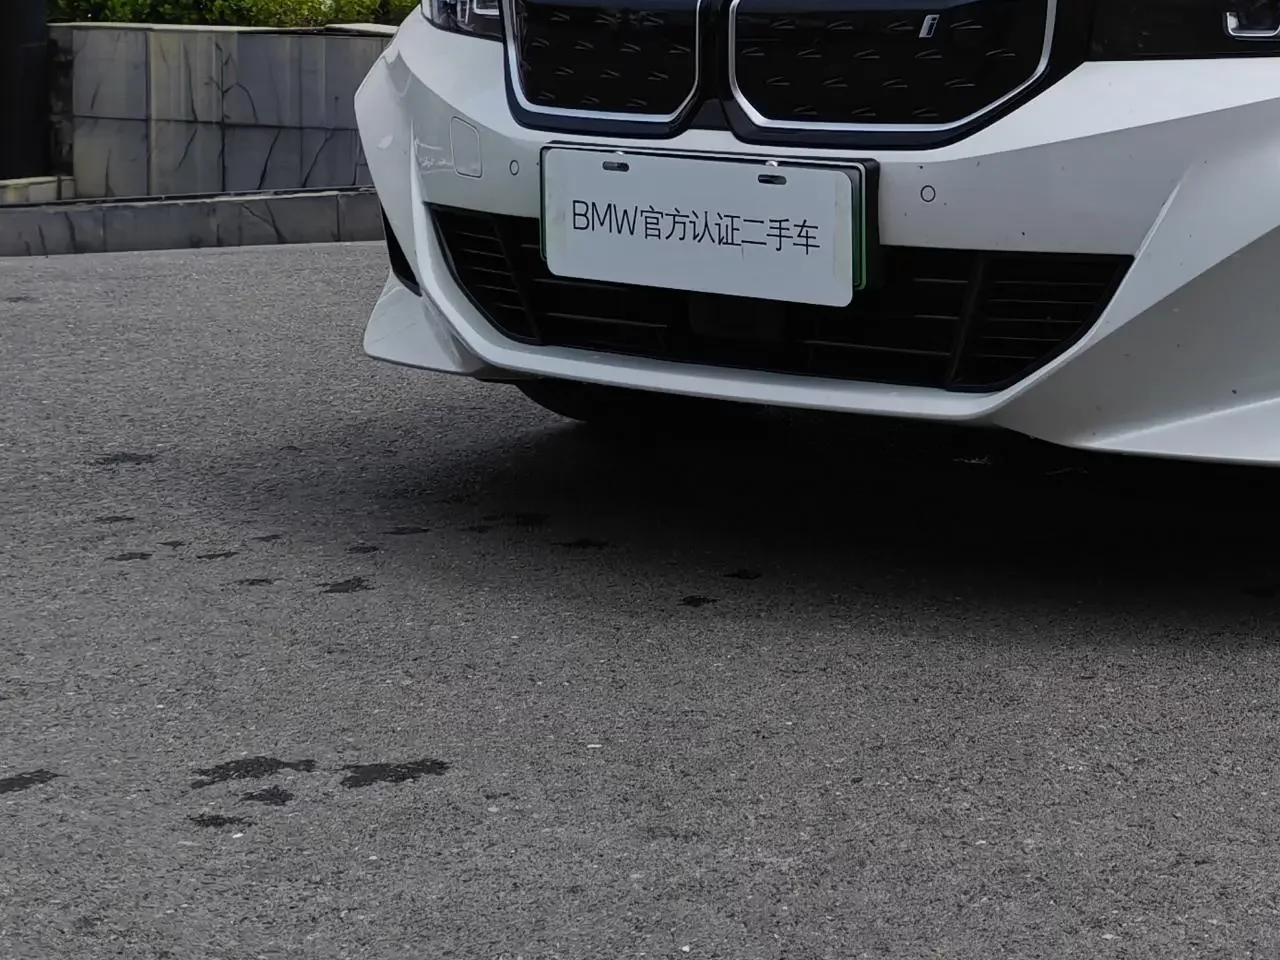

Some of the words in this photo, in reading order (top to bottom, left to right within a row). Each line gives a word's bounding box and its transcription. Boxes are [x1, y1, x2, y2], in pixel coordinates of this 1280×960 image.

[572, 200, 821, 255] BMW官方认证二手车
